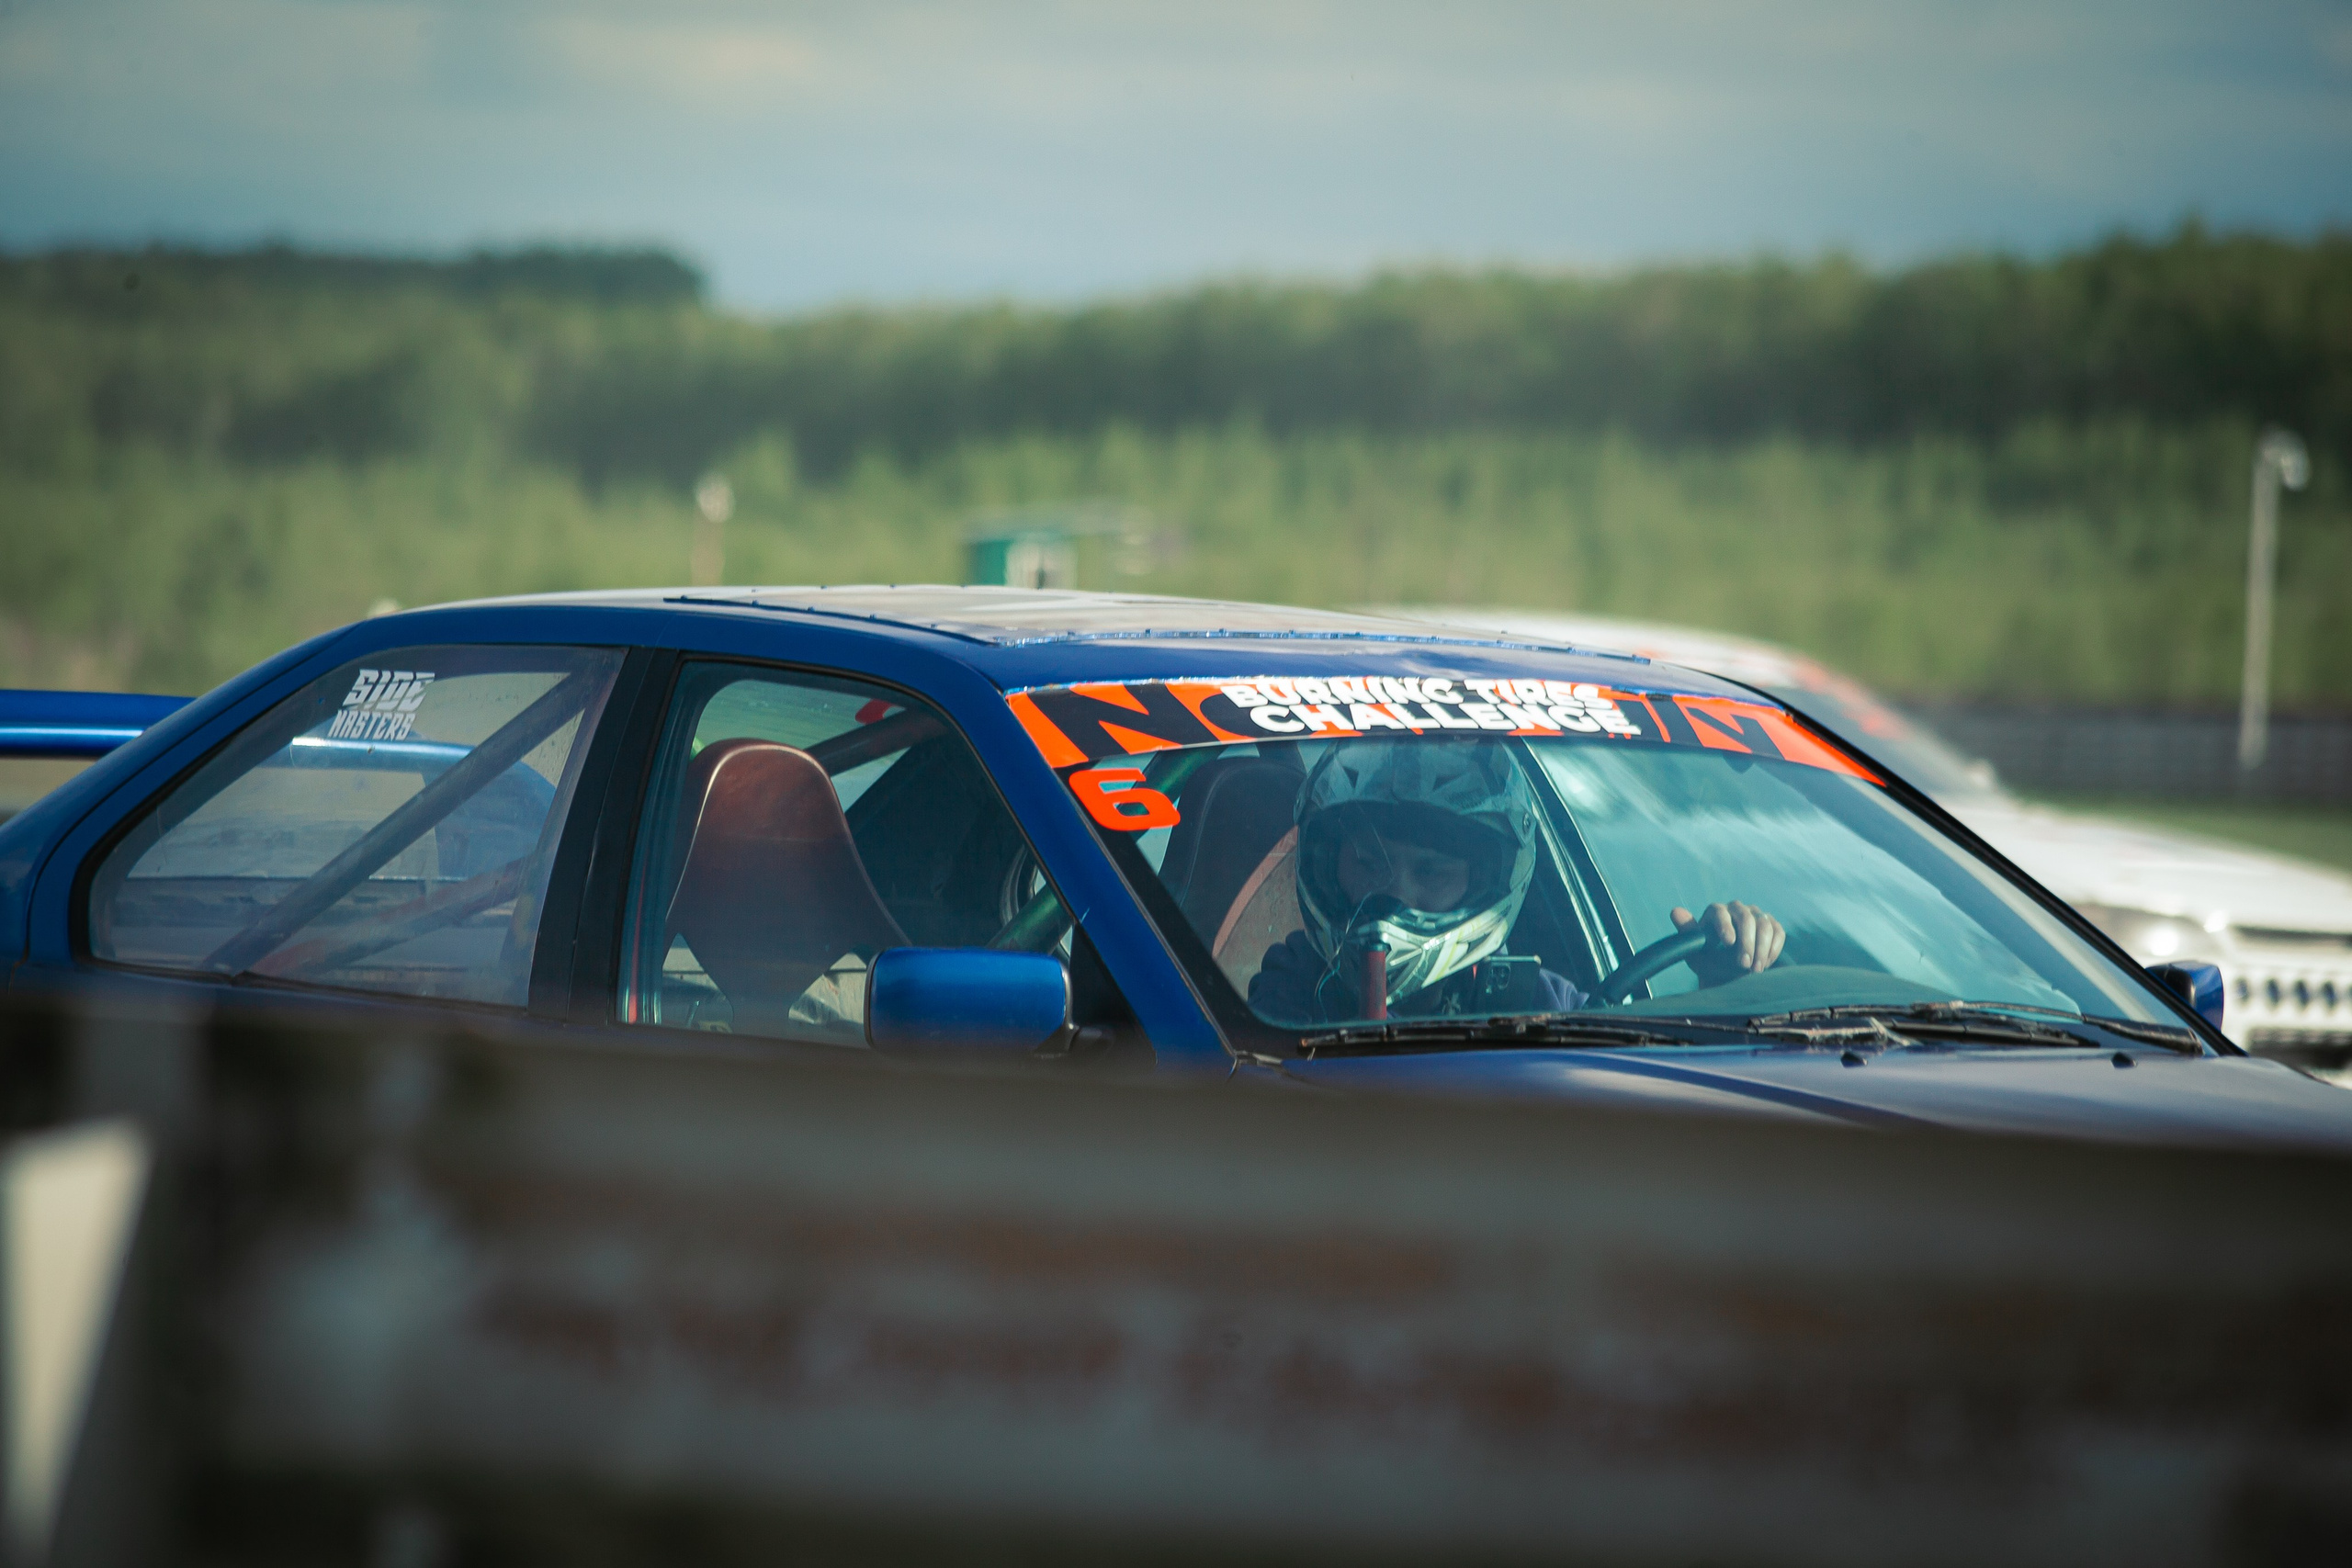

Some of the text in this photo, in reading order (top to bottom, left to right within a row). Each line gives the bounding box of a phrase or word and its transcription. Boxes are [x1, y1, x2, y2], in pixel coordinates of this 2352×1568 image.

[342, 669, 435, 711] SIDE
[1220, 677, 1613, 709] BURNING TIRES
[327, 709, 416, 740] MASTERS
[1250, 704, 1641, 735] CHALLENGE
[1069, 768, 1181, 831] 6
